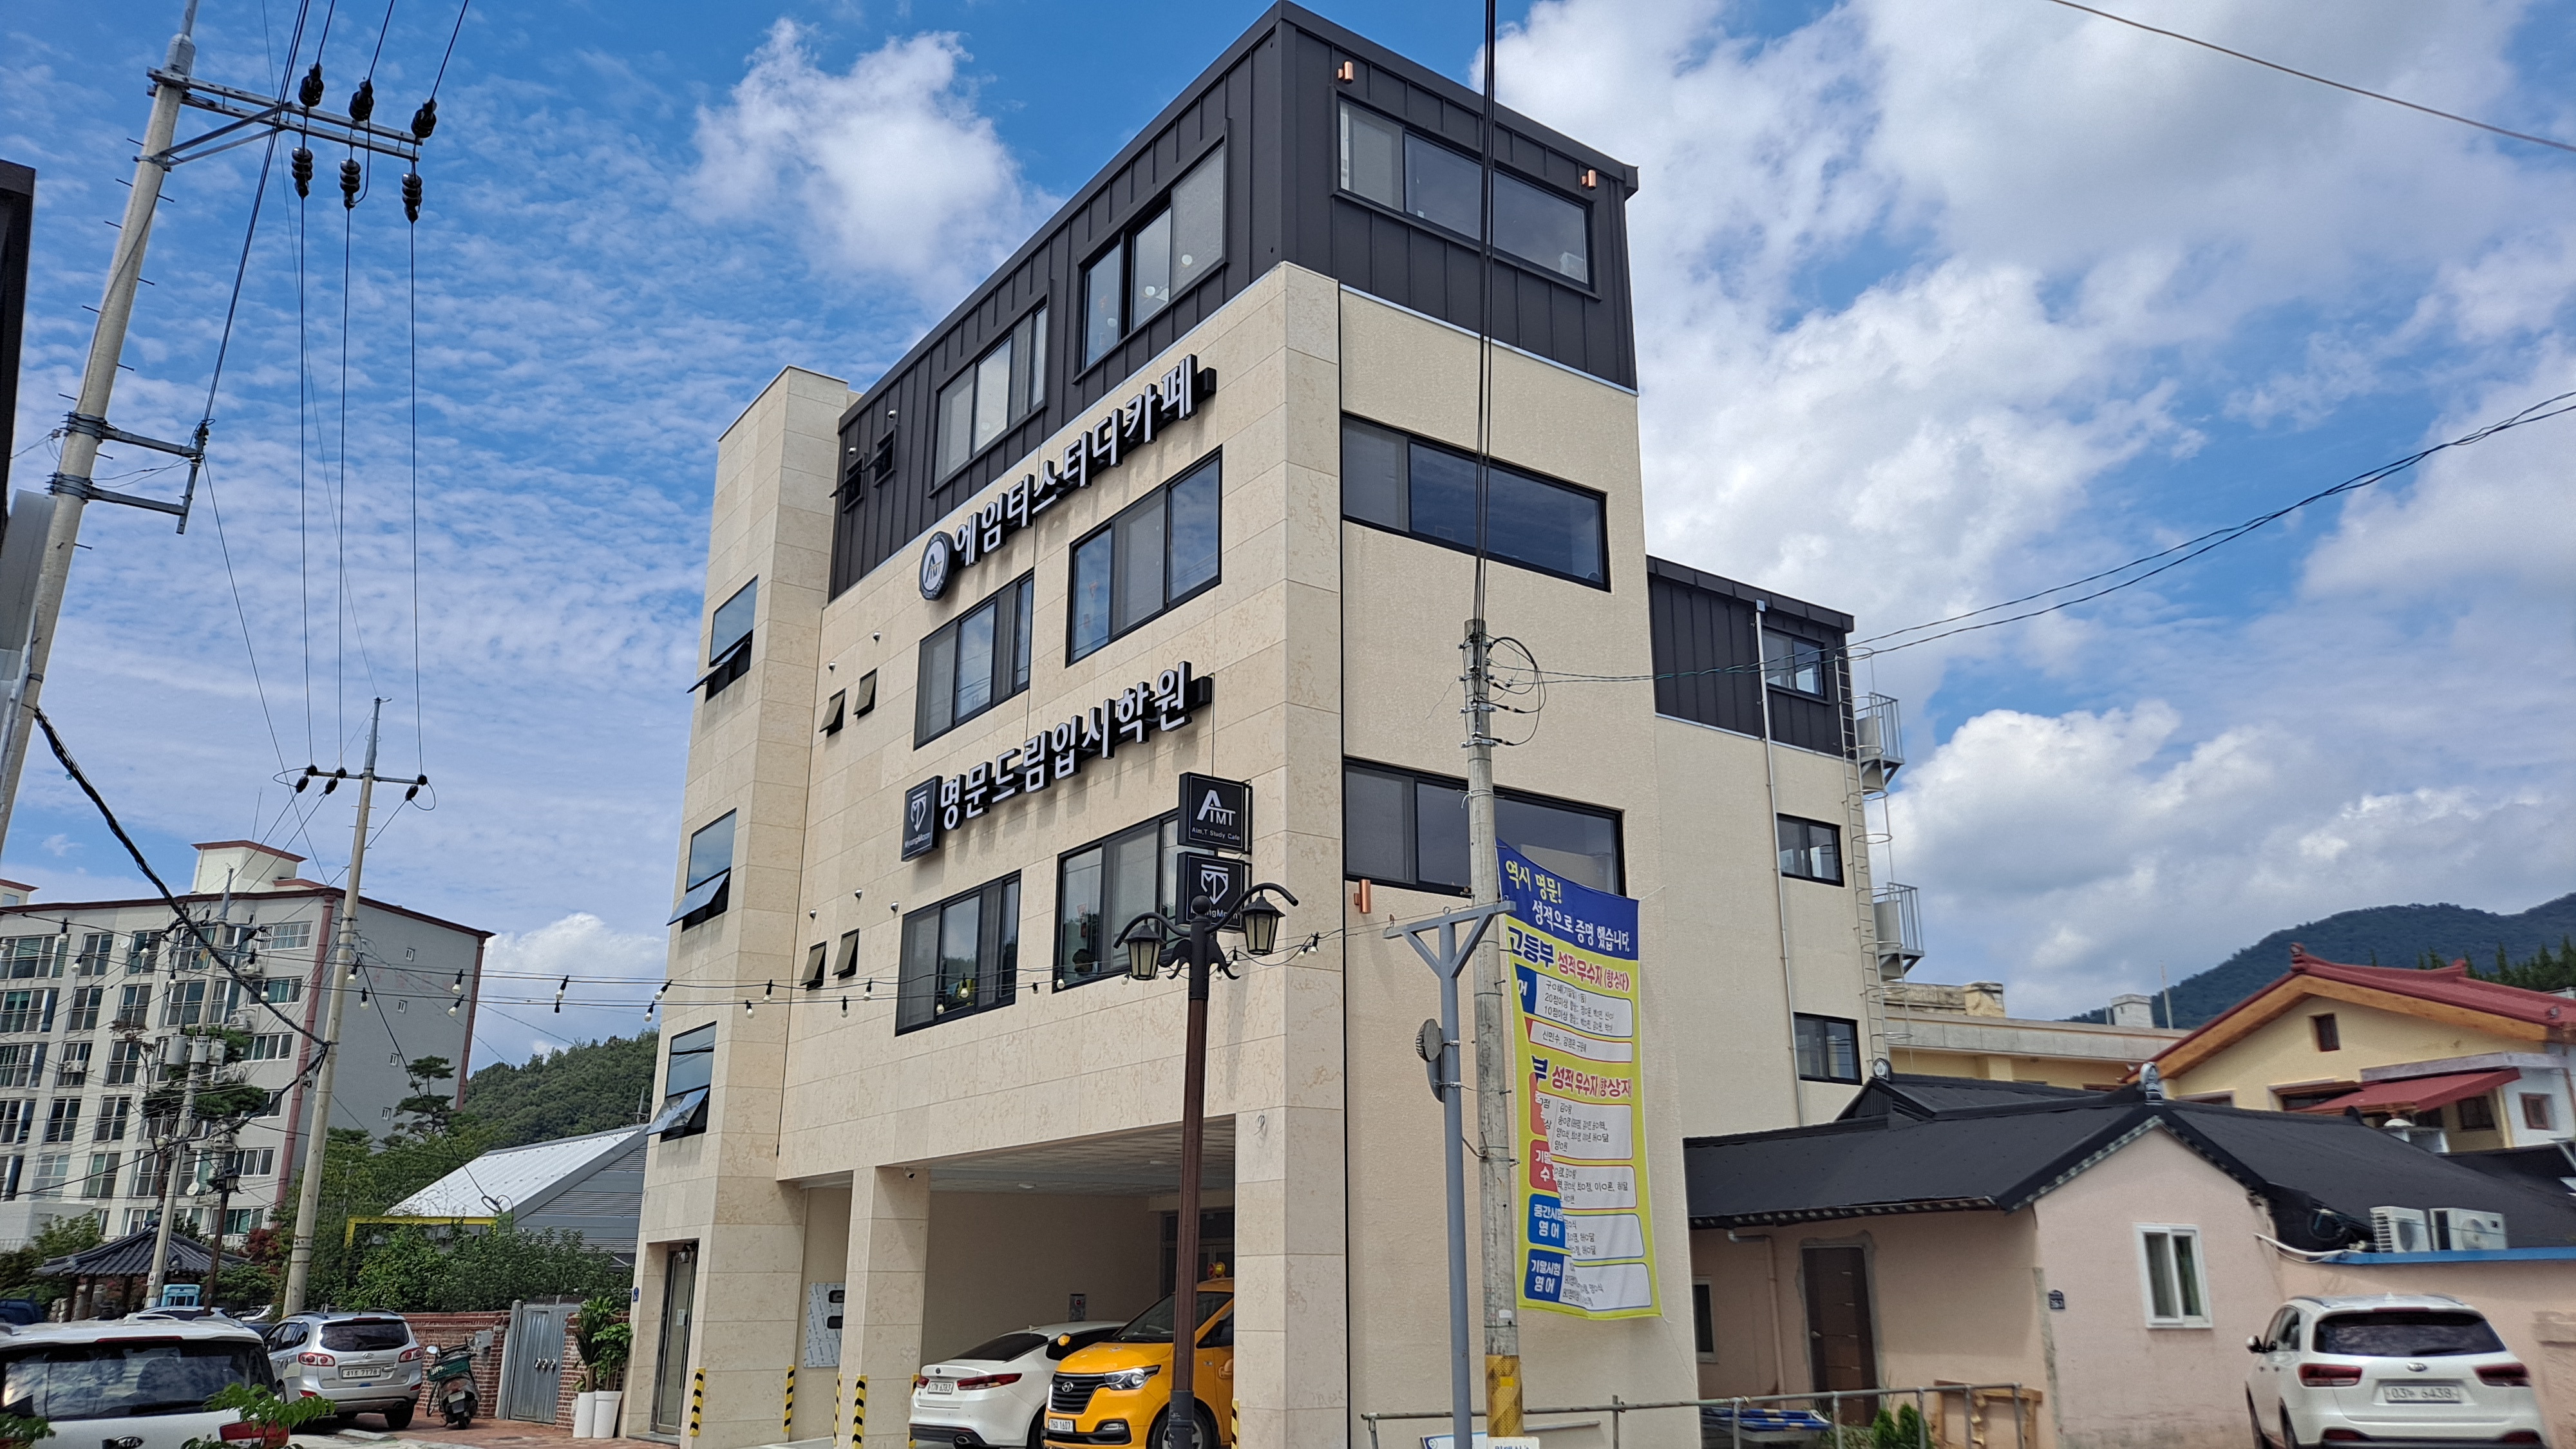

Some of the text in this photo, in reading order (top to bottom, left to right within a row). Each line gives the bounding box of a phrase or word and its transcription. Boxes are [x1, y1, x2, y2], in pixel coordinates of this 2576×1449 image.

[954, 354, 1198, 566] 에임티스터디카페
[940, 661, 1191, 829] 명문드림입시학원
[1210, 830, 1226, 839] Study
[1506, 860, 1562, 904] 역시 명문!
[1532, 900, 1573, 933] 성적으로
[1575, 919, 1594, 946] 증명
[1508, 927, 1555, 968] 고등부
[1531, 1259, 1562, 1276] 기말시험
